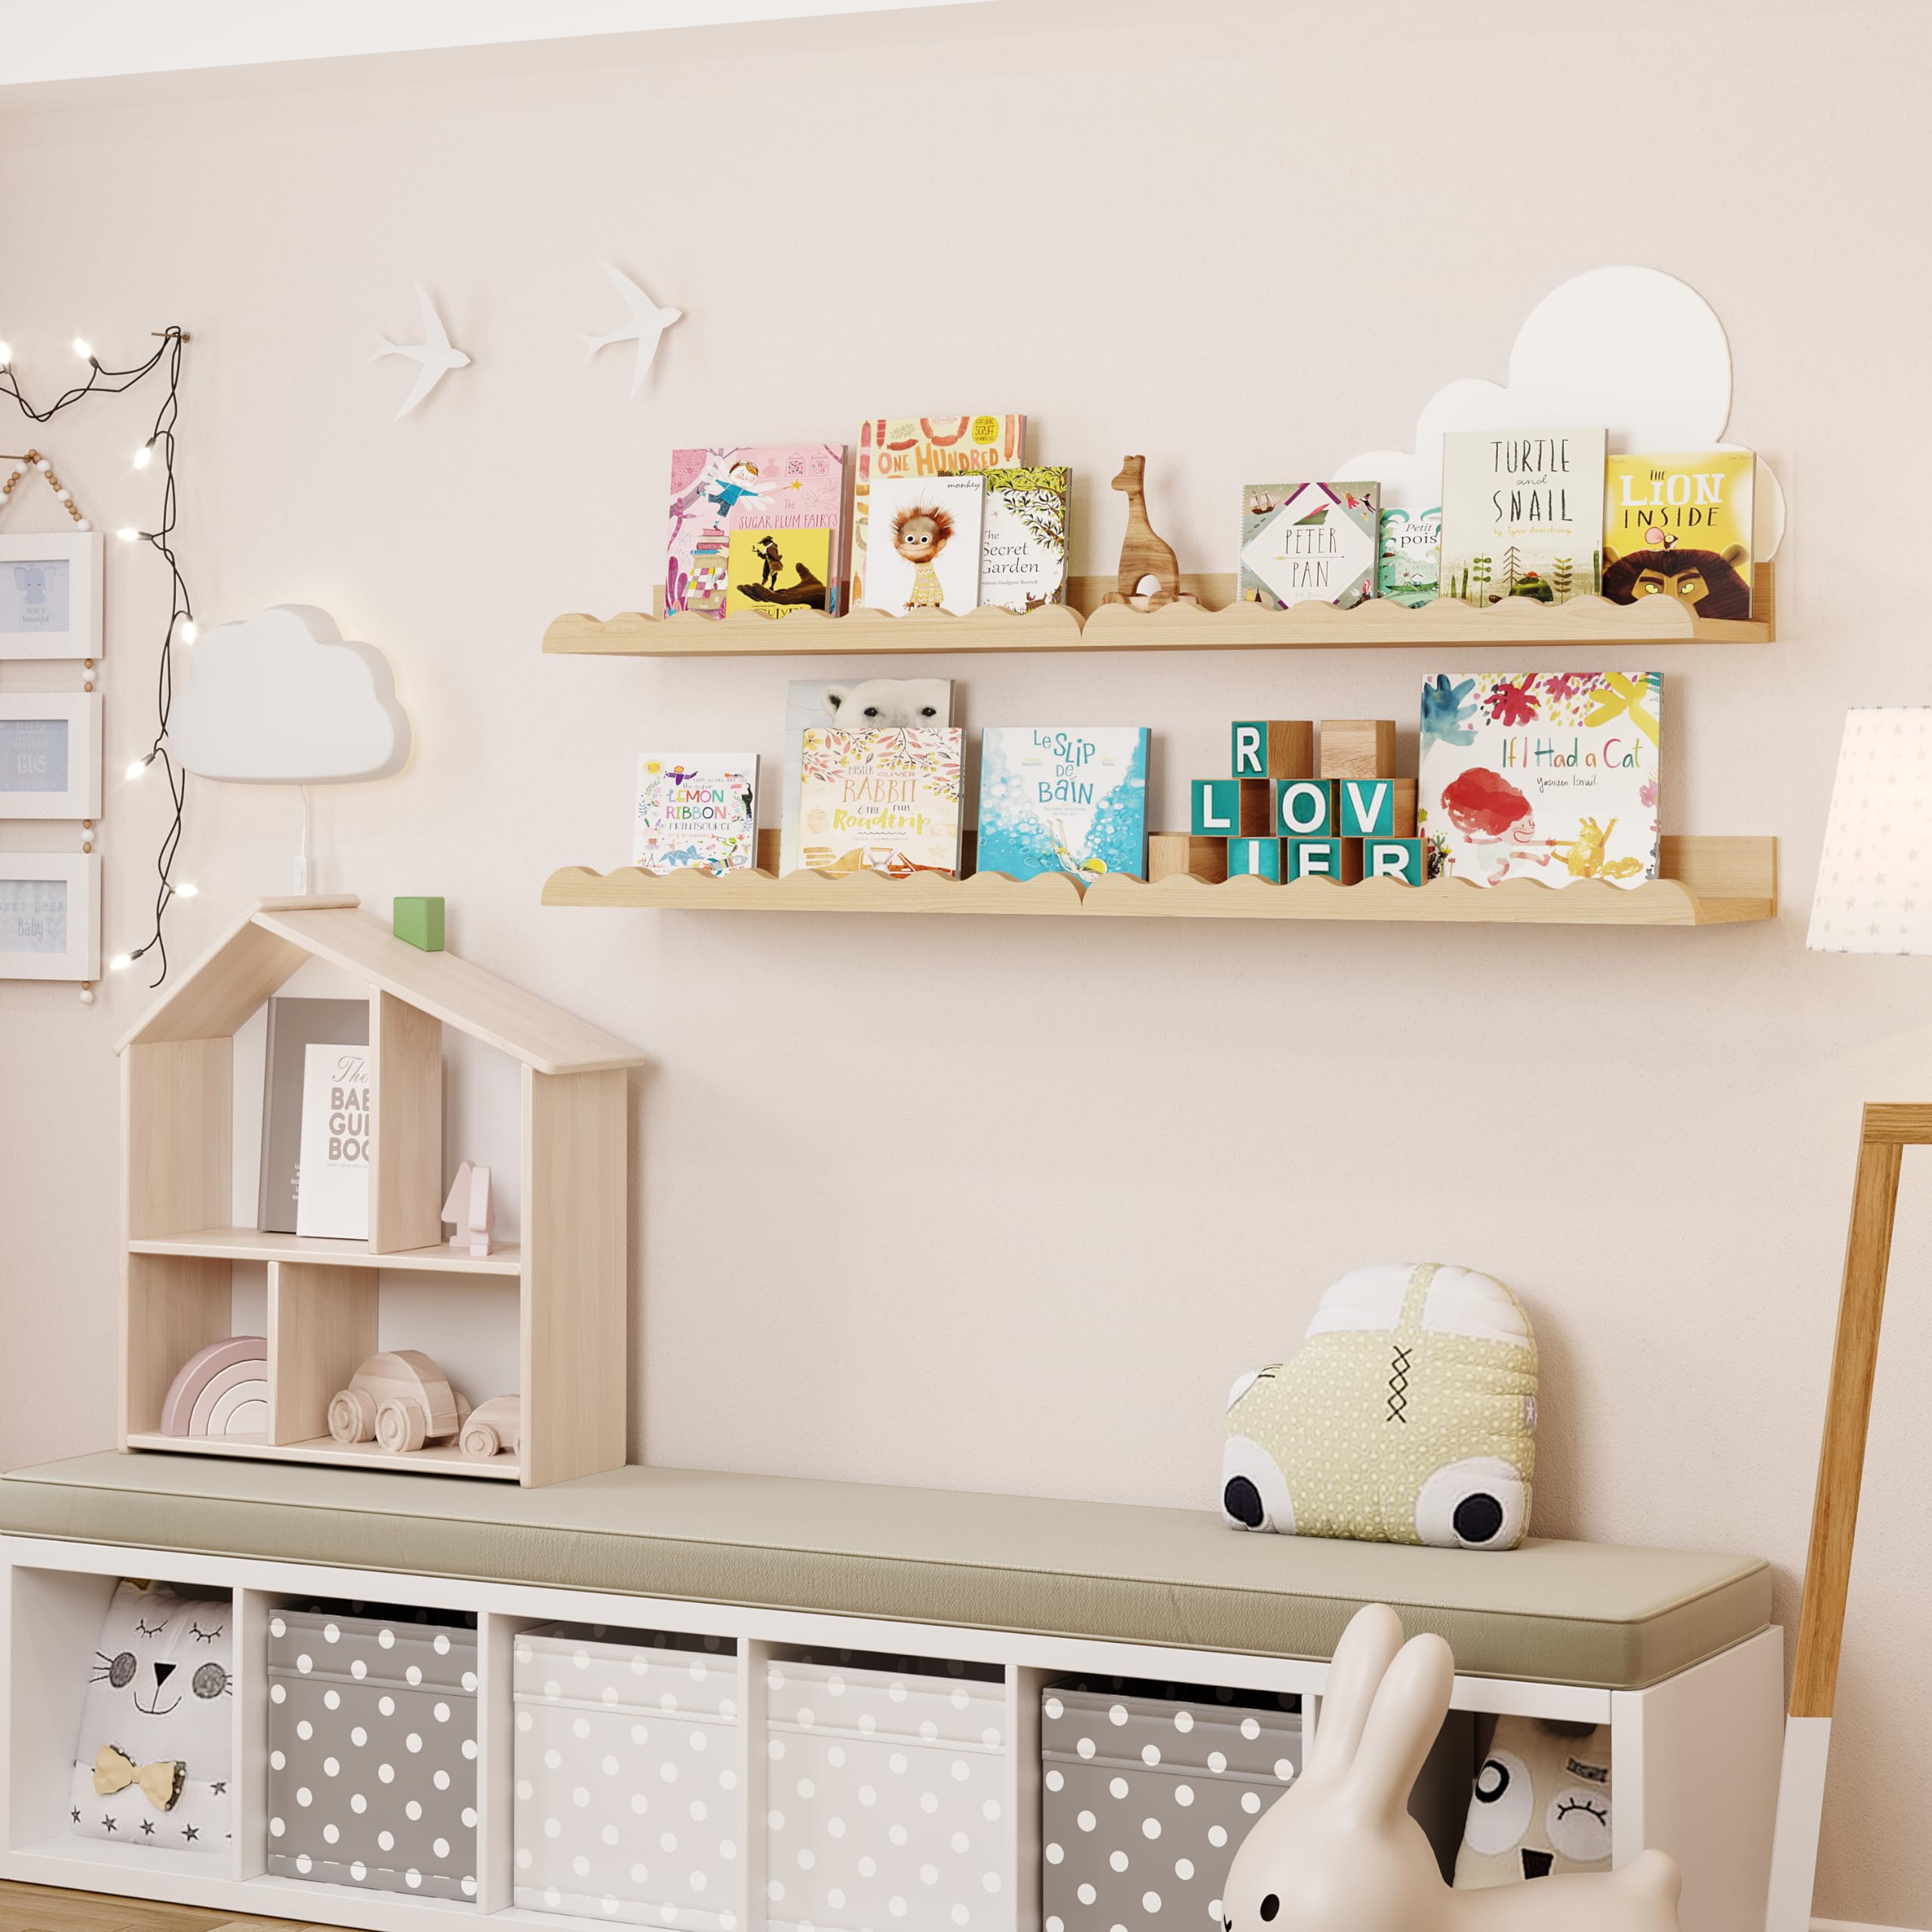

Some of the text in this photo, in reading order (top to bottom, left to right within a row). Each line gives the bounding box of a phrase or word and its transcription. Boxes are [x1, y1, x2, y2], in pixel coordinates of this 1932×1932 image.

[975, 425, 995, 435] SCRUFF
[878, 443, 999, 476] ONE HUNDRED
[1491, 438, 1570, 473] TURTLE
[947, 479, 980, 491] monkey
[1516, 474, 1548, 485] and
[1650, 469, 1666, 481] THE
[784, 499, 795, 509] The
[1493, 488, 1574, 522] SNAIL
[739, 513, 838, 529] SUGAR PLUM FAIRY'S
[1624, 507, 1720, 528] INSIDE
[1286, 528, 1337, 554] PETER
[1401, 532, 1437, 547] pois
[1292, 561, 1329, 587] PAN
[1034, 730, 1051, 749] Le
[1236, 727, 1263, 774] R
[1503, 737, 1643, 768] If I Had a Cat
[848, 766, 874, 775] MISTER
[1573, 774, 1599, 786] Ismail
[667, 789, 724, 802] LEMON
[841, 777, 918, 803] RABBIT
[666, 806, 726, 820] RIBBON
[832, 808, 931, 835] Roadtrip
[18, 917, 43, 942] Baby
[332, 1055, 369, 1083] The
[331, 1088, 370, 1112] BAB
[329, 1112, 370, 1137] GUI
[329, 1137, 369, 1161] BO
